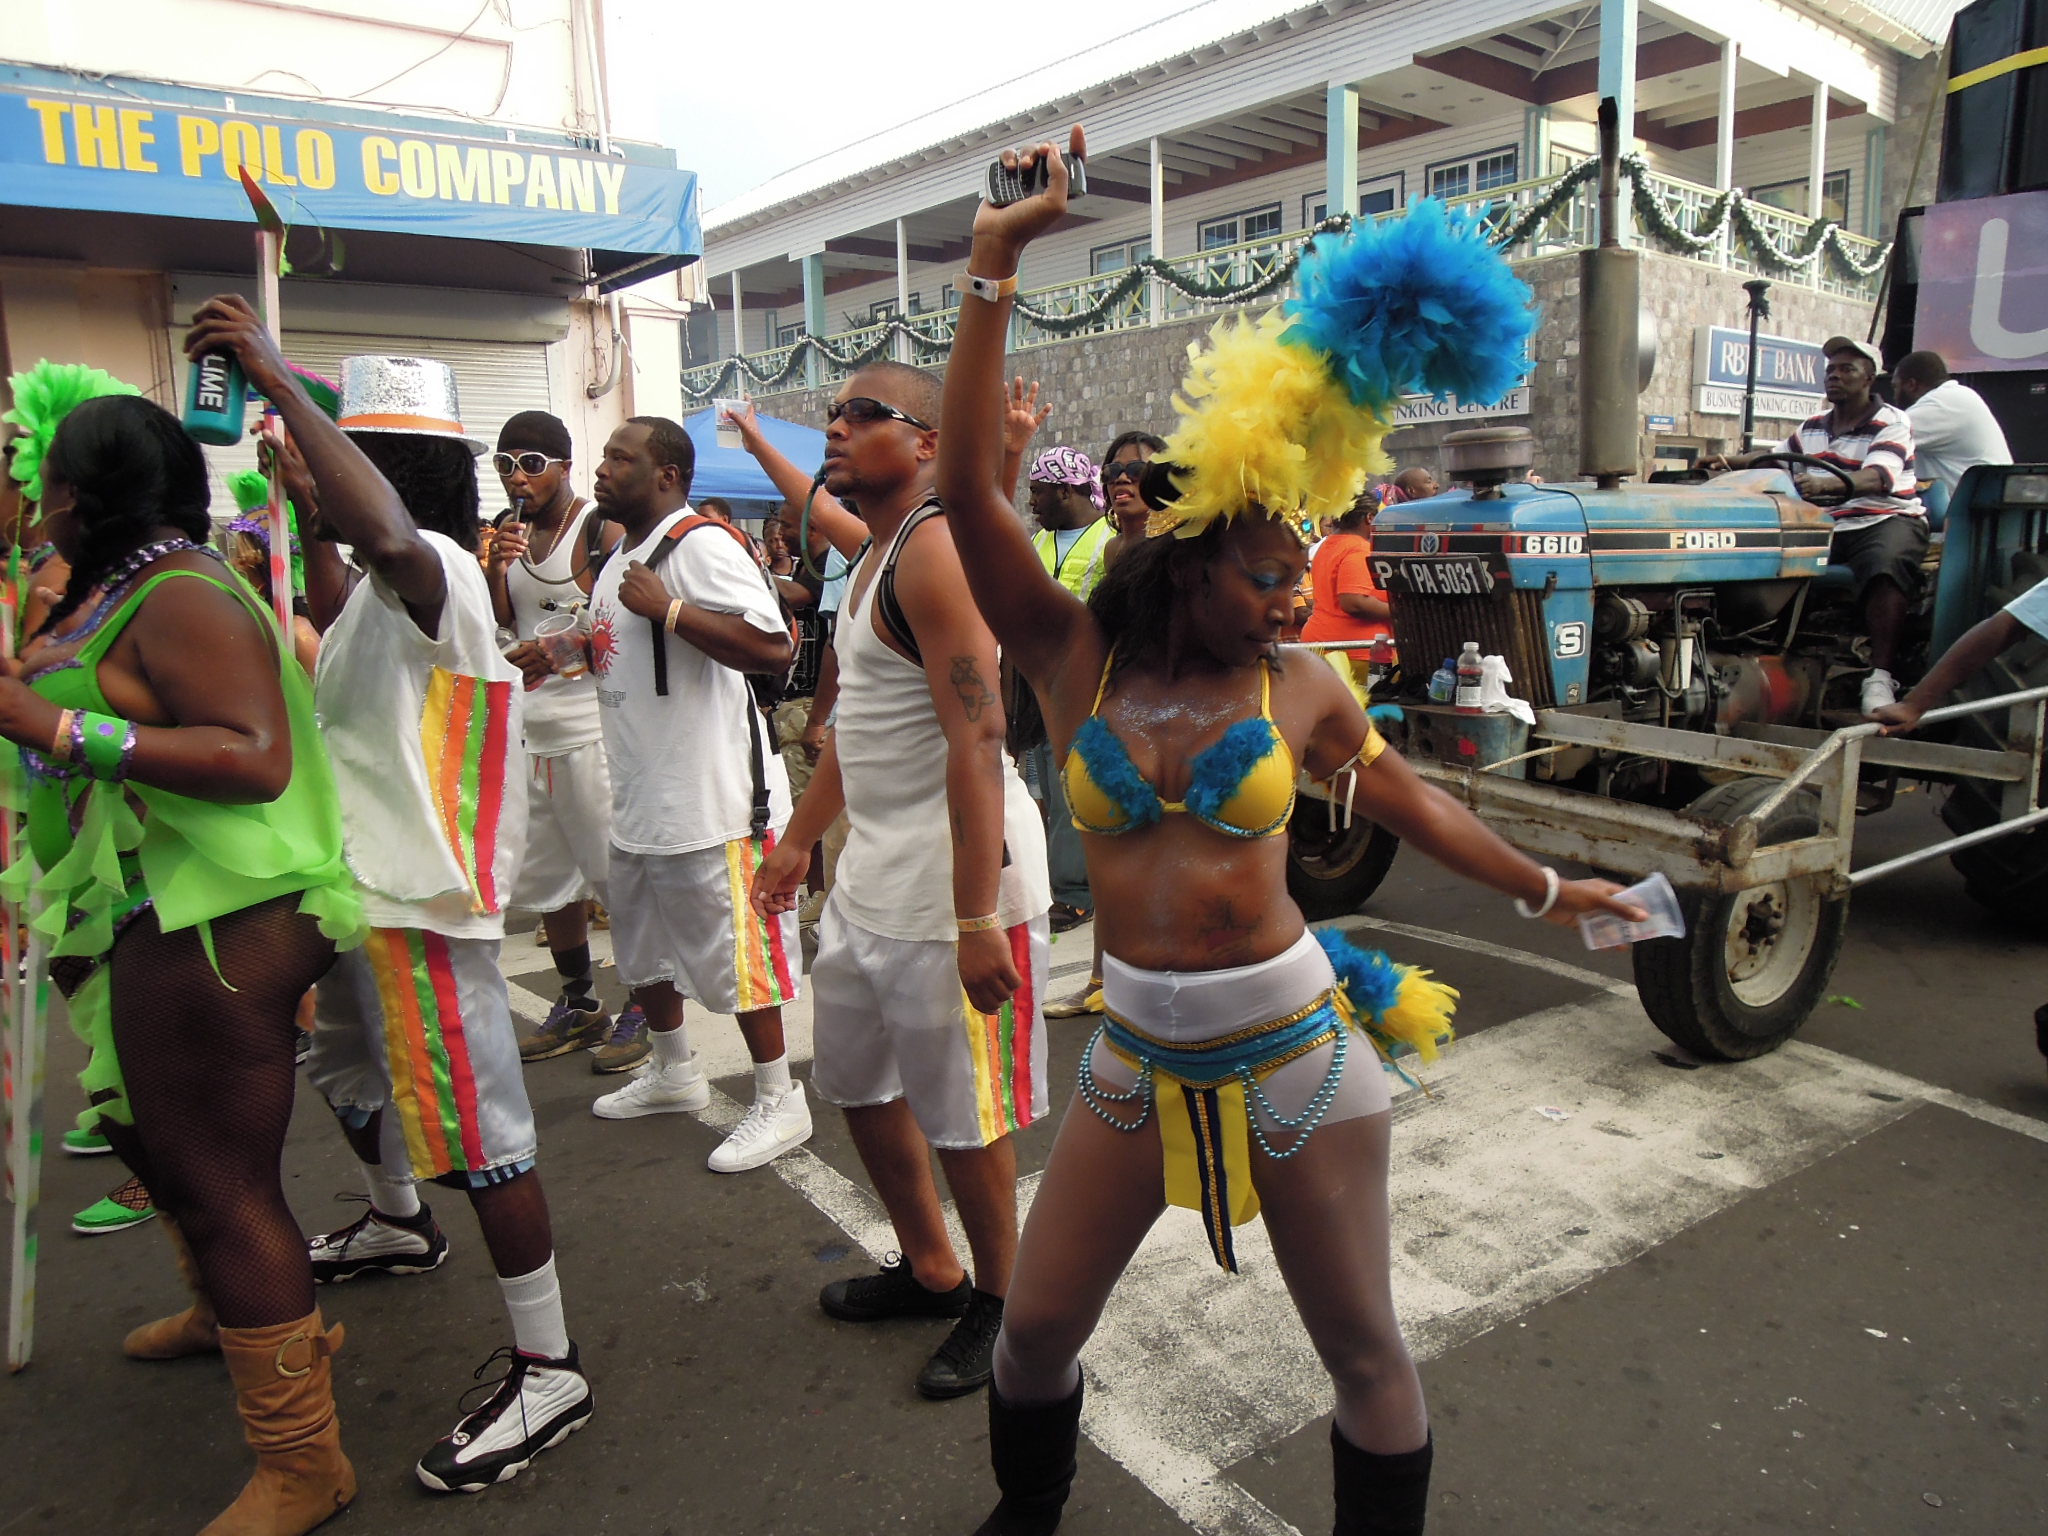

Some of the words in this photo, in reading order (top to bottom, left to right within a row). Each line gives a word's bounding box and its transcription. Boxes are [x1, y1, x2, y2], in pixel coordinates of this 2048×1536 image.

[27, 97, 158, 173] THE
[177, 114, 337, 190] POLO
[361, 135, 626, 215] COMPANY
[198, 354, 226, 408] LIME
[1774, 349, 1817, 385] BANK
[1755, 395, 1788, 413] ANKING
[1526, 535, 1583, 554] 6610
[1670, 531, 1736, 549] FORD
[1411, 563, 1439, 594] PA
[1435, 562, 1481, 594] 5031
